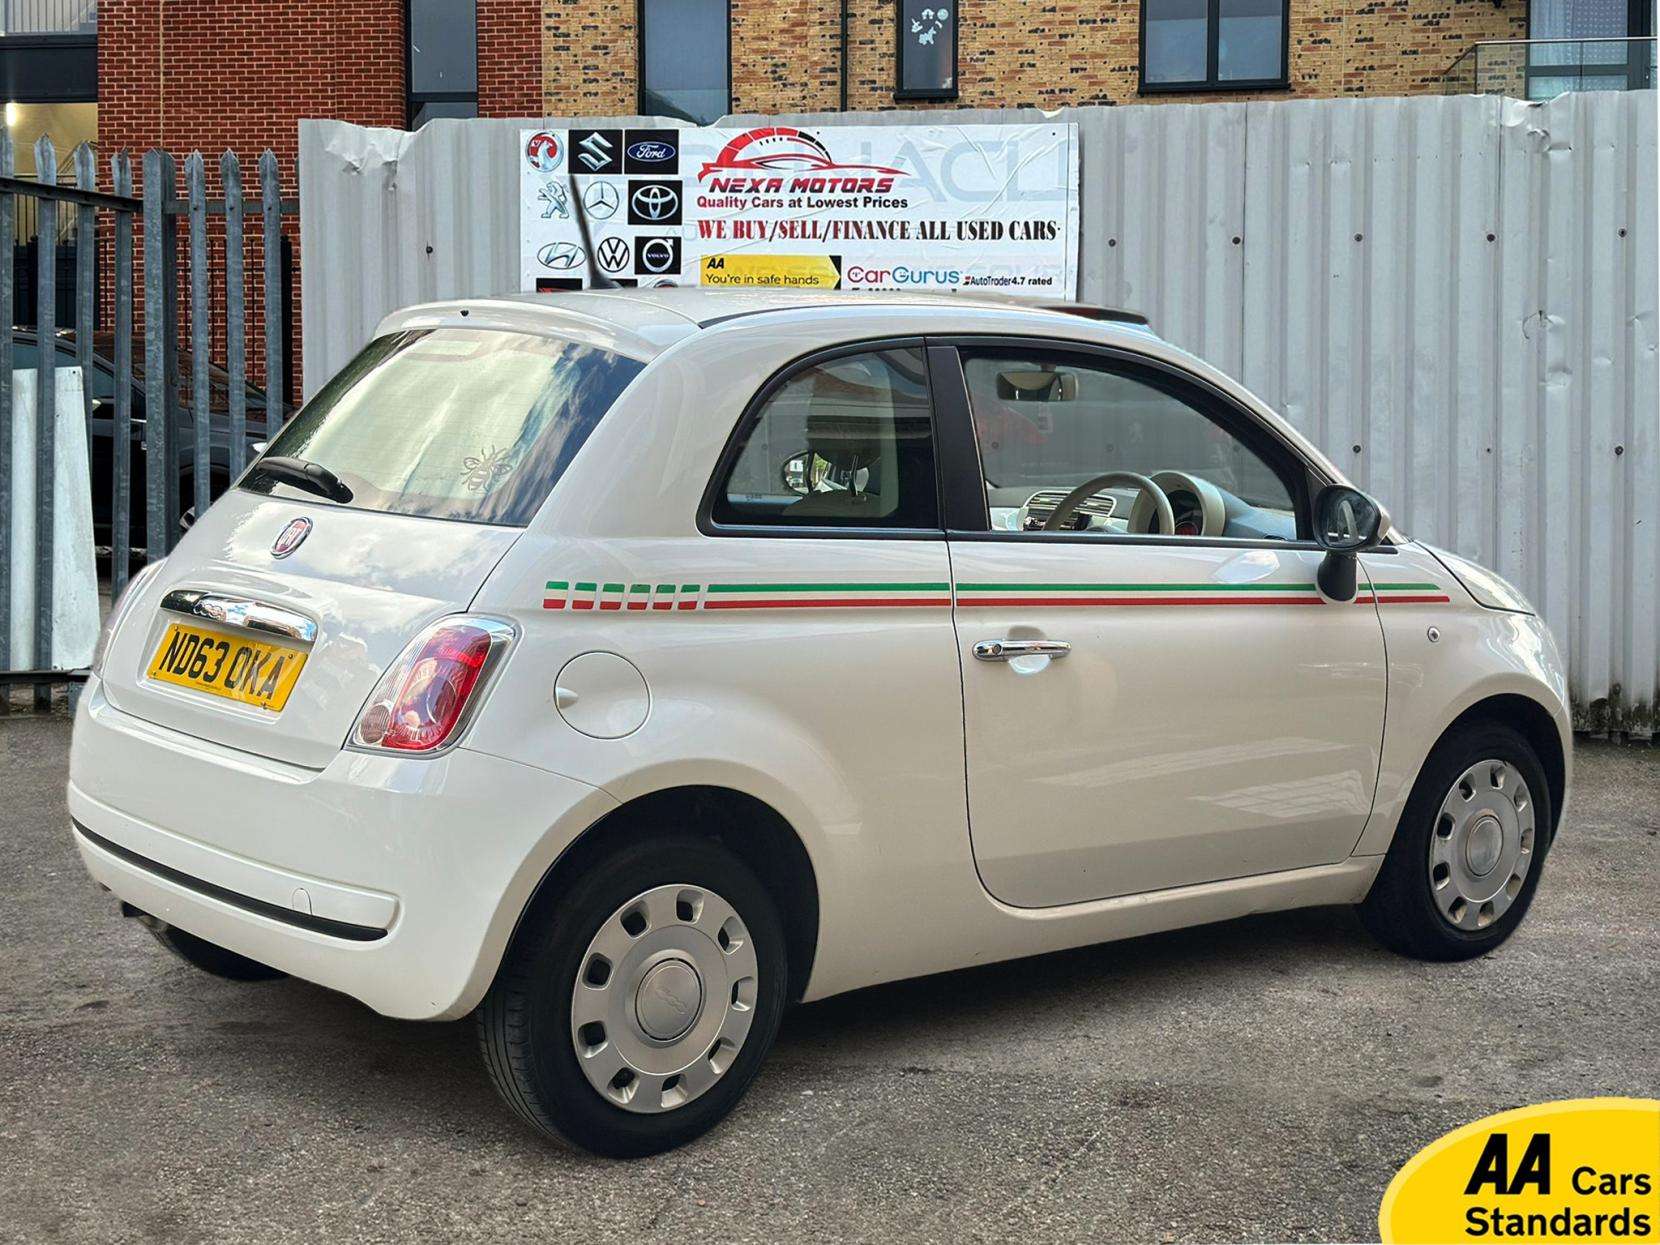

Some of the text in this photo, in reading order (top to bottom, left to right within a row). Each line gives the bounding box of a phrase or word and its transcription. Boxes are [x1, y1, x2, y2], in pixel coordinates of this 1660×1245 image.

[632, 143, 667, 159] Ford
[708, 178, 895, 194] NEXA MOTORS
[697, 196, 909, 210] Quality Cars at Lowest Prices
[698, 220, 727, 240] WE
[916, 220, 951, 240] ALL
[957, 220, 1004, 240] USED
[1008, 220, 1057, 241] CARS
[707, 258, 725, 269] AA
[706, 274, 820, 286] You're in safe hands
[847, 266, 960, 284] CarGurus
[1028, 276, 1053, 286] rated
[159, 631, 286, 699] ND63 OKA
